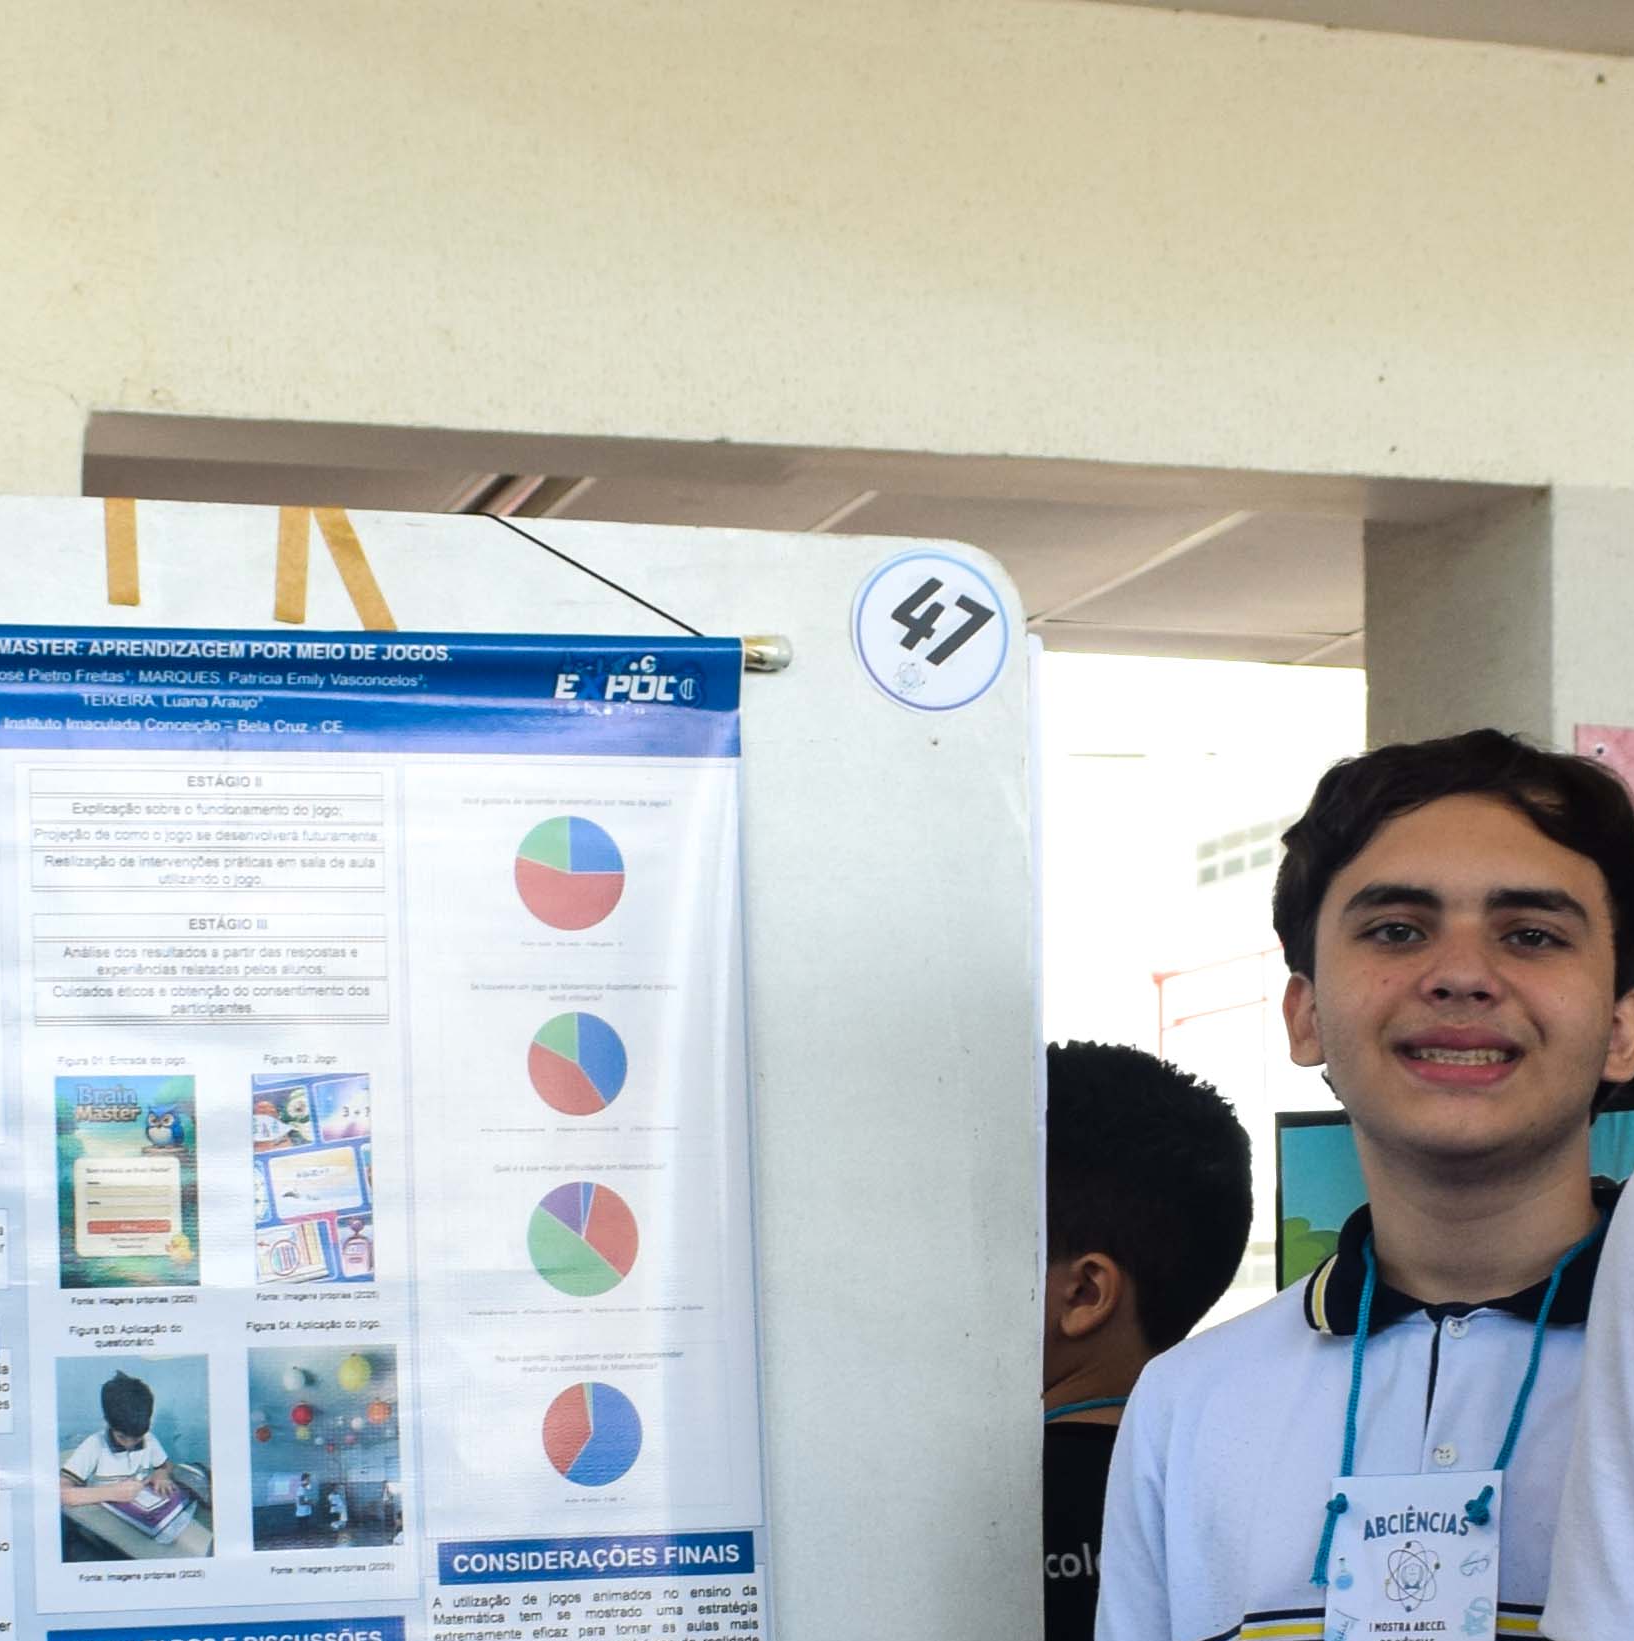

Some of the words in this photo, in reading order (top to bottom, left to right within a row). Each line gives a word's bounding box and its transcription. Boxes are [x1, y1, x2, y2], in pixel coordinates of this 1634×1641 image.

[891, 577, 995, 666] 47
[88, 640, 244, 659] APRENDIZAGEM
[250, 642, 291, 659] POR
[297, 643, 342, 660] MEIO
[350, 644, 375, 660] DE
[381, 644, 453, 662] JOGOS.
[28, 668, 71, 682] Pietro
[287, 673, 325, 688] Emily
[163, 695, 208, 709] Luana
[3, 718, 62, 731] Instituto
[66, 718, 141, 731] Imaculada
[237, 719, 270, 733] Bela
[274, 720, 308, 733] Cruz
[321, 720, 343, 734] CE
[187, 773, 251, 788] ESTÁGIO
[188, 916, 252, 930] ESTÁGIO
[76, 1084, 138, 1107] Brain
[75, 1103, 141, 1123] Master
[1364, 1505, 1470, 1541] ABCIÊNCIAS
[453, 1545, 657, 1573] CONSIDERAÇÕES
[665, 1544, 740, 1565] FINAIS
[1045, 1542, 1100, 1578] col
[432, 1594, 442, 1608] A
[452, 1592, 511, 1610] utilização
[521, 1591, 538, 1604] de
[548, 1589, 581, 1607] jogos
[592, 1586, 652, 1602] animados
[663, 1589, 679, 1599] no
[689, 1583, 731, 1598] ensino
[741, 1582, 757, 1596] da
[1374, 1621, 1410, 1632] MOSTRA
[1413, 1620, 1446, 1632] ABCCEL
